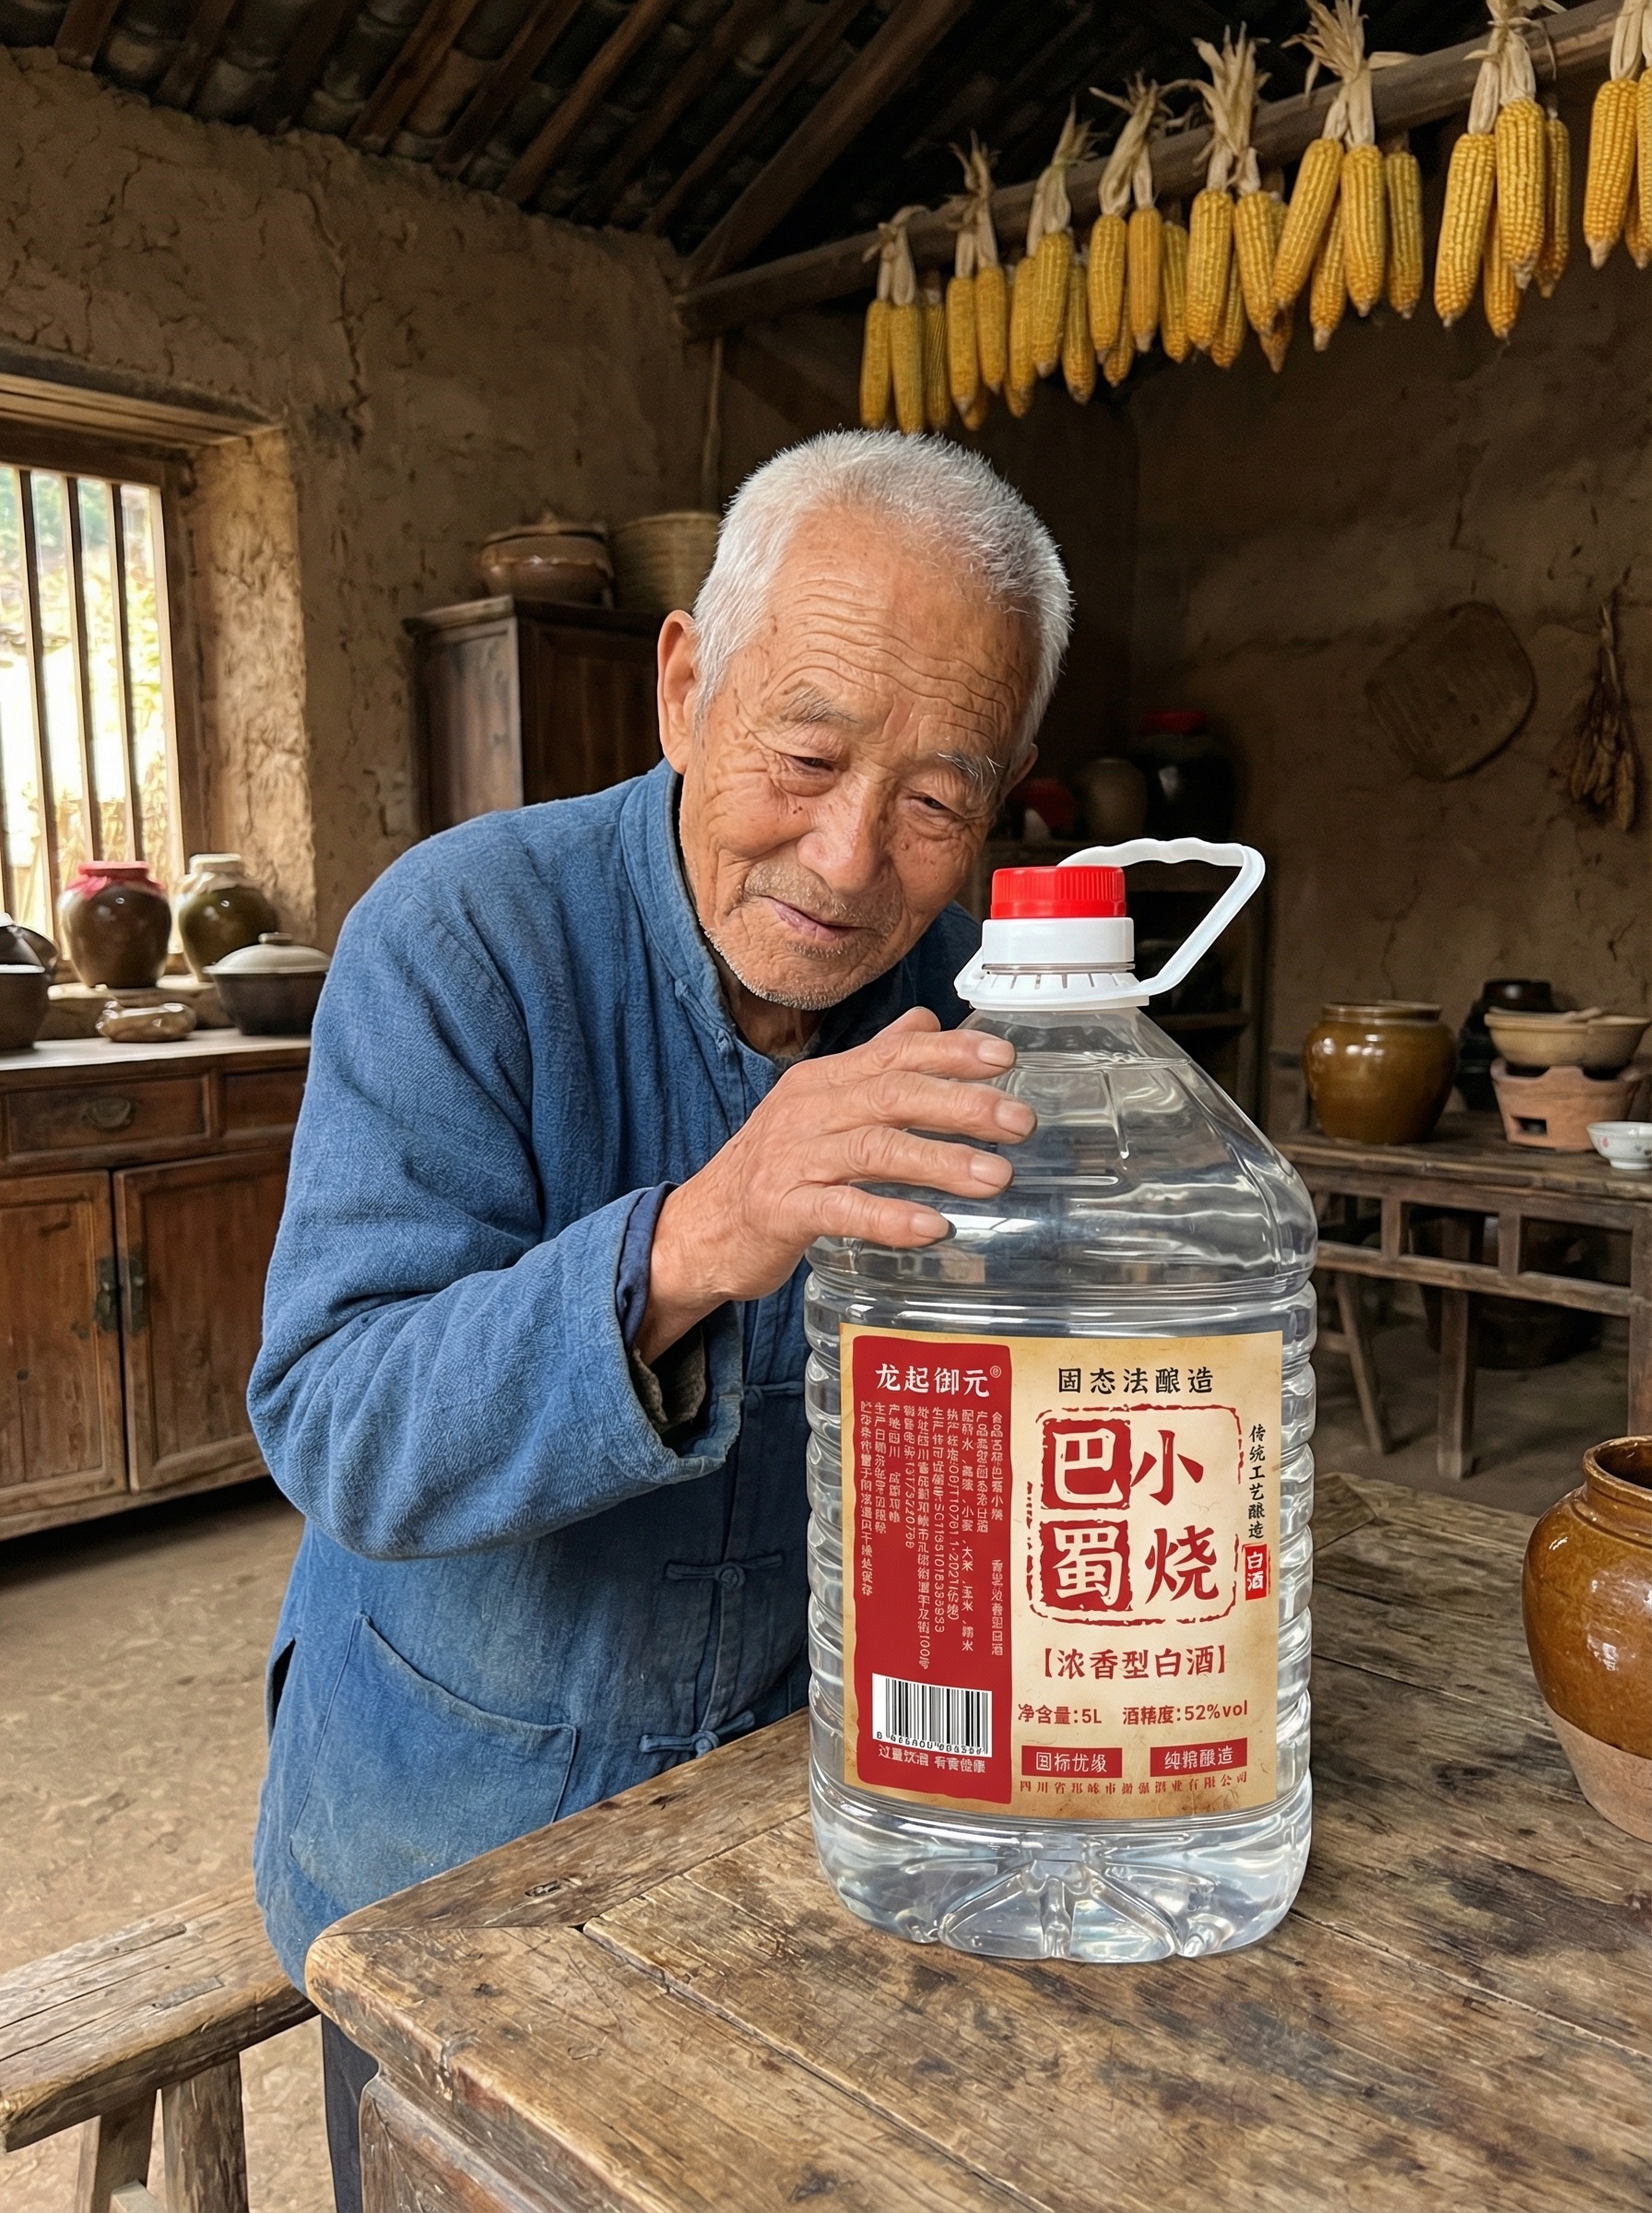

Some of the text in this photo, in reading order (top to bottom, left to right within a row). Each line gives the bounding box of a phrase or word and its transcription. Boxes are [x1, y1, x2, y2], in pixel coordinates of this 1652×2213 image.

[876, 1363, 990, 1398] 龙起御元
[1057, 1367, 1214, 1395] 固态法酿造
[1248, 1424, 1267, 1539] 传统工艺酿造
[1247, 1552, 1263, 1592] 白酒
